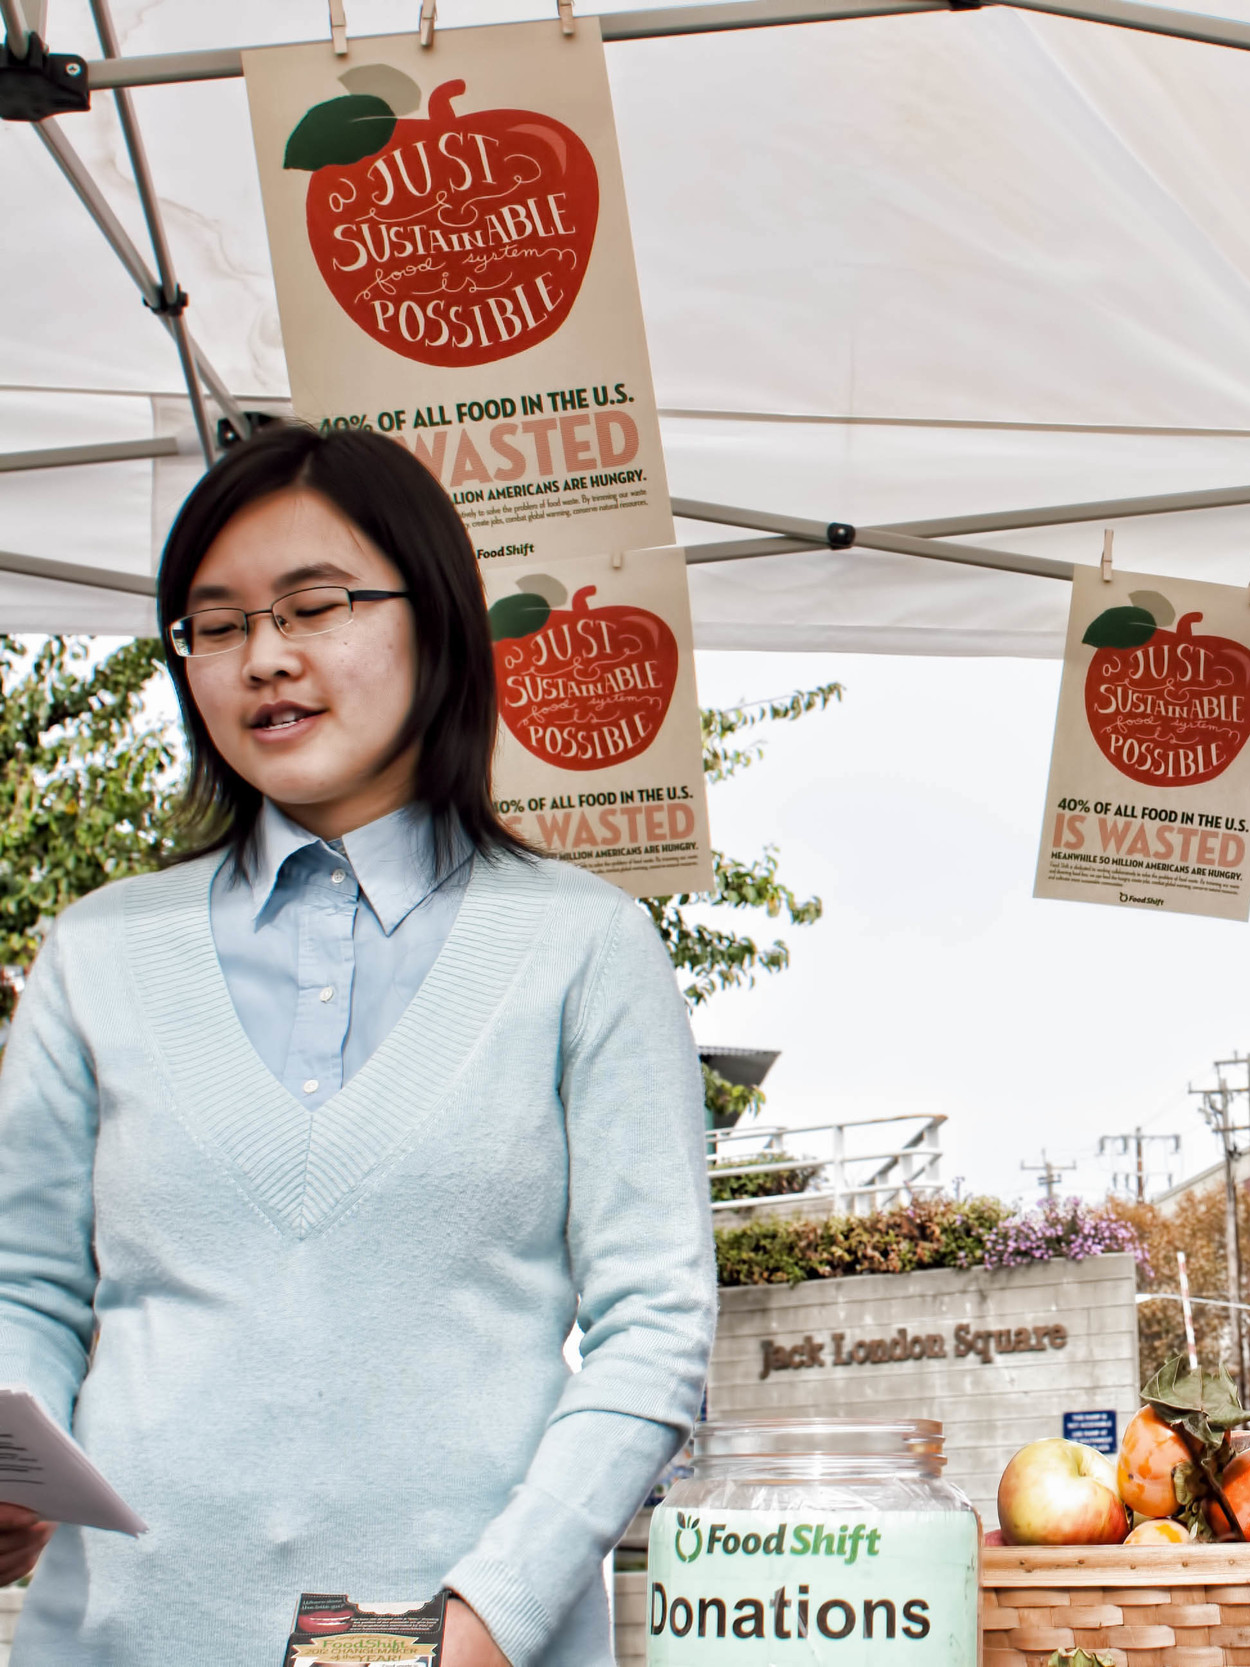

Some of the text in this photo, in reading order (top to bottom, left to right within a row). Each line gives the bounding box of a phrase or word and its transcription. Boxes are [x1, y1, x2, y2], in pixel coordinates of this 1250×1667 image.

[328, 132, 499, 213] a JUST
[332, 192, 576, 271] SUSTAINABLE
[358, 243, 565, 300] food system
[370, 272, 564, 348] POSSIBLE
[377, 409, 407, 432] OF
[413, 404, 452, 430] ALL
[456, 397, 517, 424] FOOD
[522, 393, 544, 416] IN
[547, 388, 590, 414] THE
[592, 383, 635, 407] U.S.
[487, 480, 560, 501] AMERICANS
[563, 476, 588, 492] ARE
[590, 469, 647, 488] HUNGRY.
[477, 543, 535, 560] Food Shift
[505, 619, 616, 668] a JUST
[1102, 643, 1214, 682] a JUST
[505, 661, 663, 708] SUSTAINABLE
[1094, 684, 1245, 723] SUSTAINABLE
[521, 693, 649, 723] food system
[1106, 715, 1162, 734] food
[528, 711, 652, 760] POSSIBLE
[1110, 734, 1226, 777] POSSIBLE
[528, 797, 546, 812] OF
[550, 795, 575, 810] ALL
[578, 792, 617, 808] FOOD
[620, 790, 635, 805] IN
[637, 788, 664, 803] THE
[666, 785, 694, 801] U.S.
[1057, 798, 1249, 833] 40% OF ALL FOOD IN THE U.S.
[536, 802, 695, 849] WASTED
[1052, 813, 1246, 869] IS WASTED
[559, 851, 594, 861] MILLION
[594, 848, 642, 859] AMERICANS
[644, 844, 661, 855] ARE
[662, 842, 699, 854] HUNGRY.
[1051, 851, 1243, 881] MEANWHILE 50 MILLION AMERICANS ARE HUNGRY.
[759, 1320, 1068, 1380] Jack London Square
[706, 1523, 882, 1565] Food Shift
[650, 1581, 931, 1640] Donations
